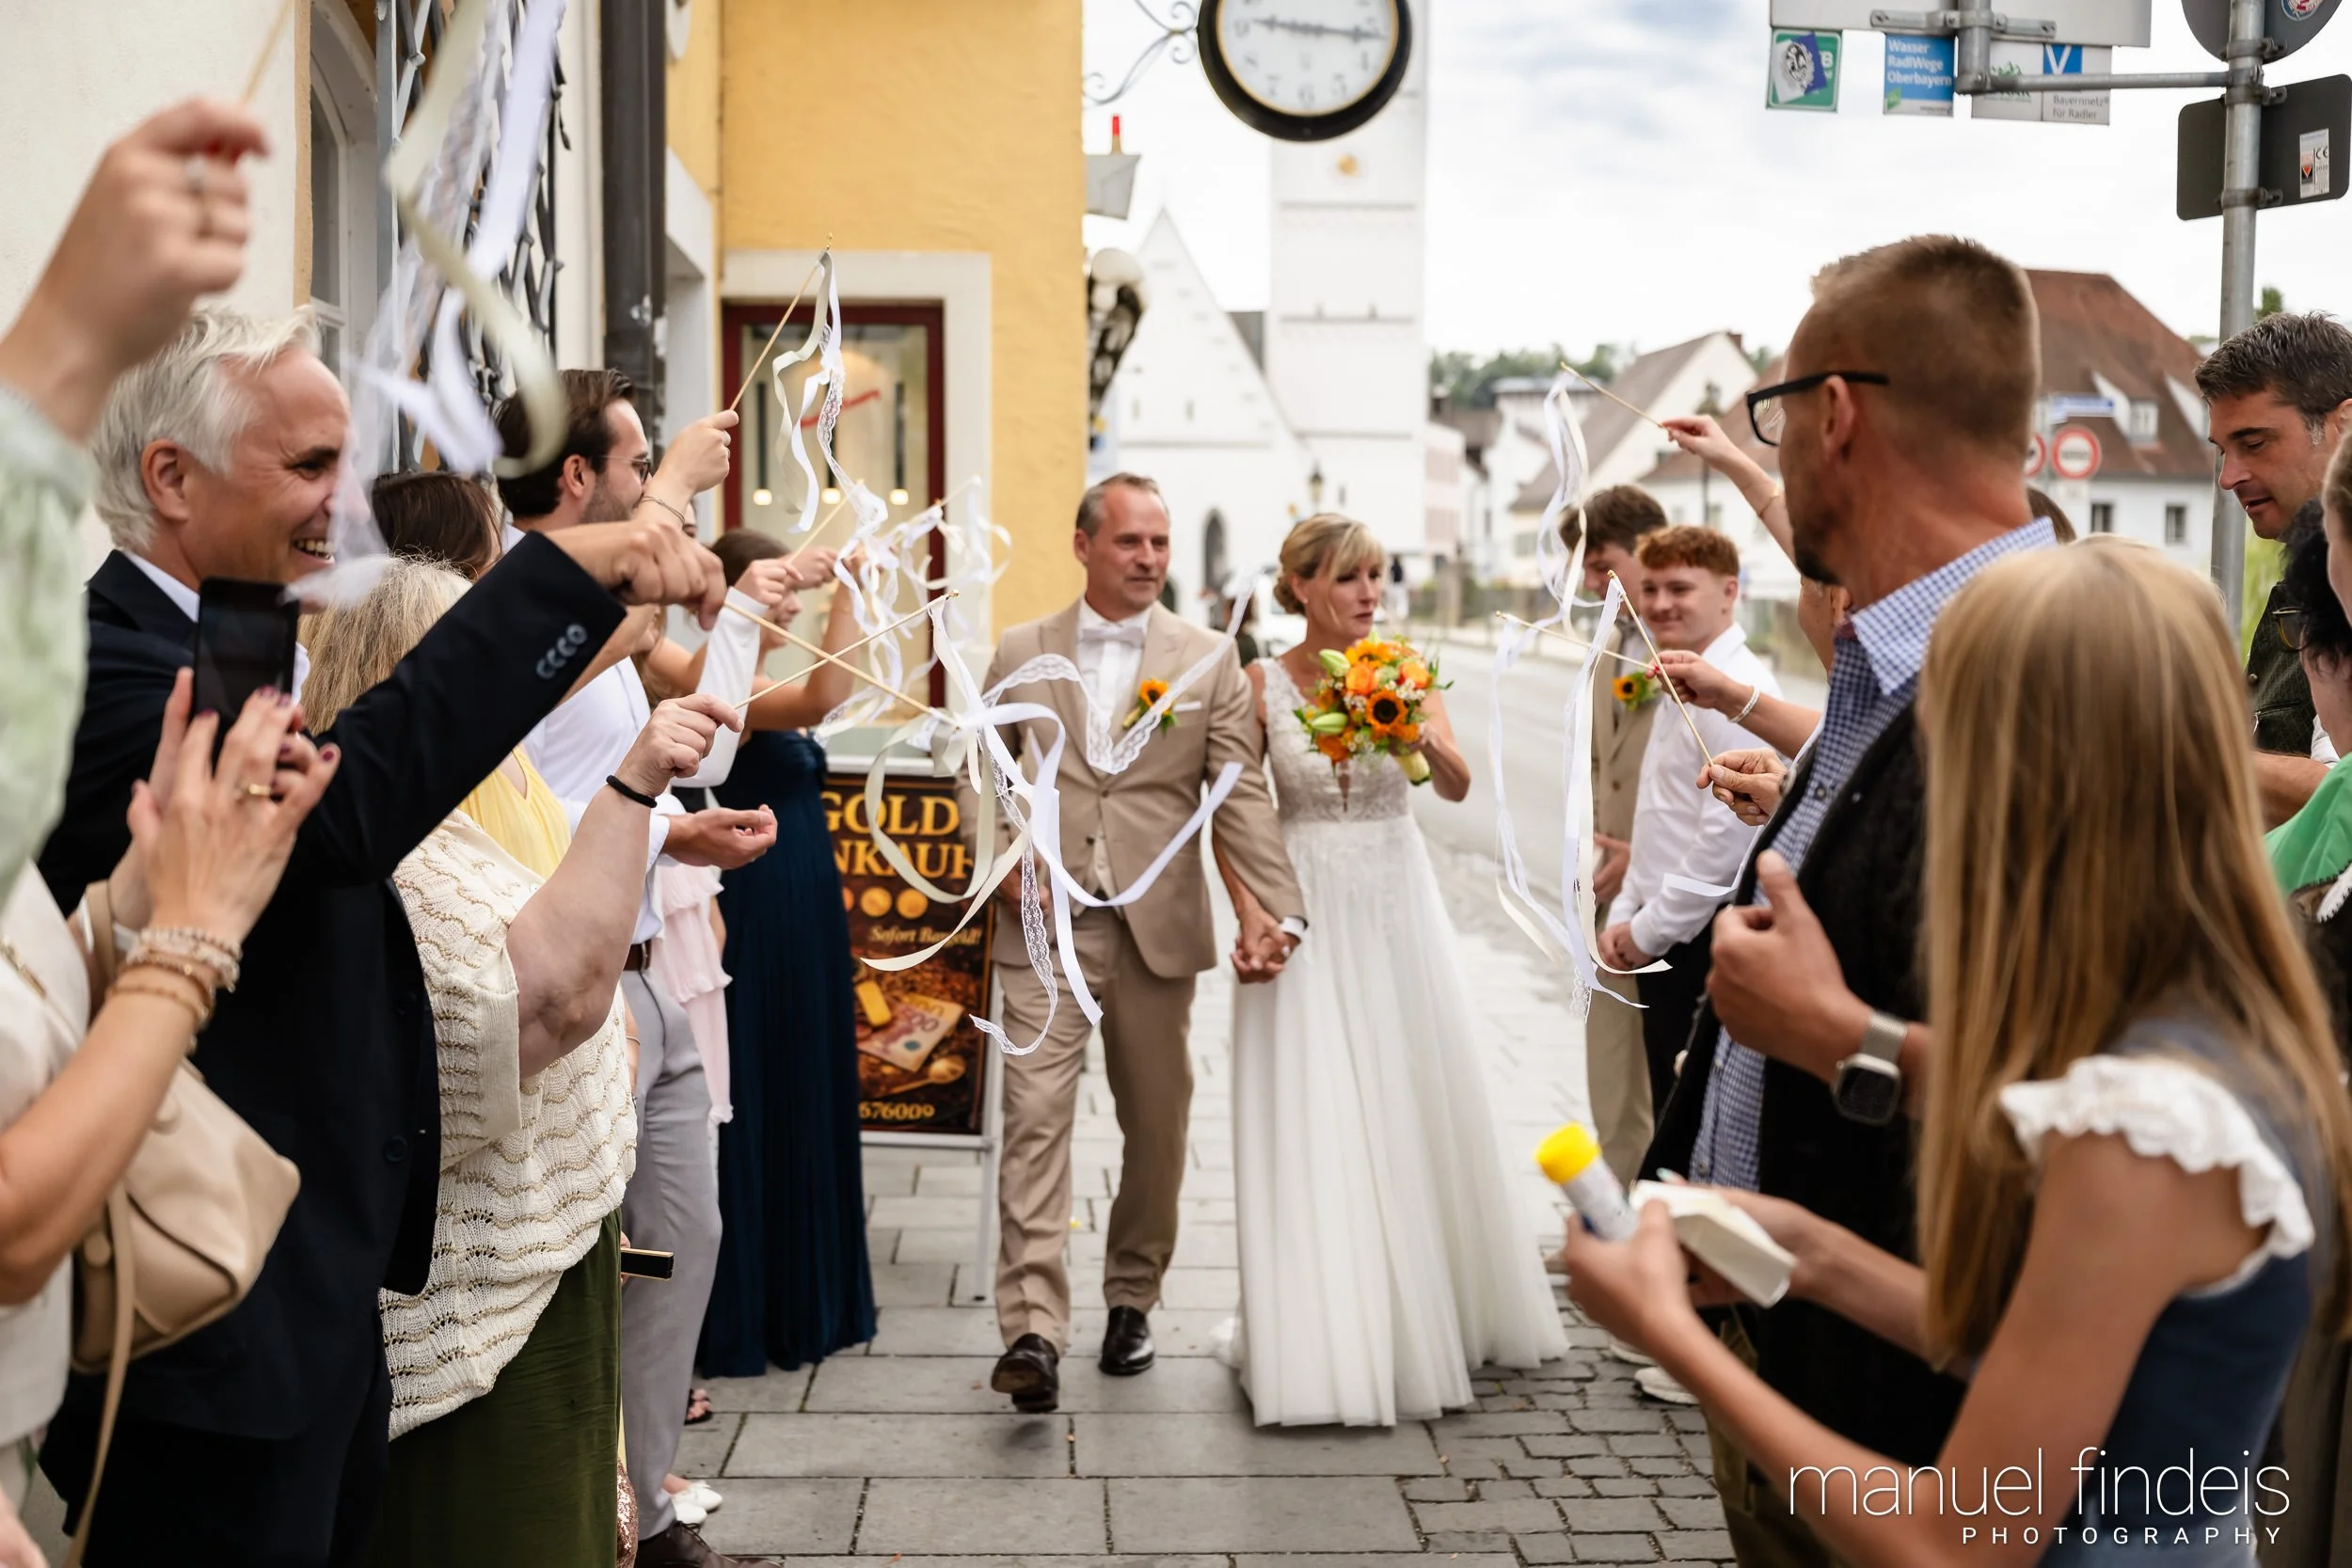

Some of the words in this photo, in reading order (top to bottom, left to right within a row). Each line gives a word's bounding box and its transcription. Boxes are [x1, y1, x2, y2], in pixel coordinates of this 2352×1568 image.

[1888, 40, 1931, 54] Wasser
[1887, 55, 1944, 73] RadlWege
[1887, 70, 1952, 88] Oberbayern
[2053, 107, 2067, 119] für
[2070, 108, 2098, 120] Radler
[820, 791, 961, 836] GOLD
[834, 839, 974, 880] NKAUF
[871, 925, 916, 945] Sofort
